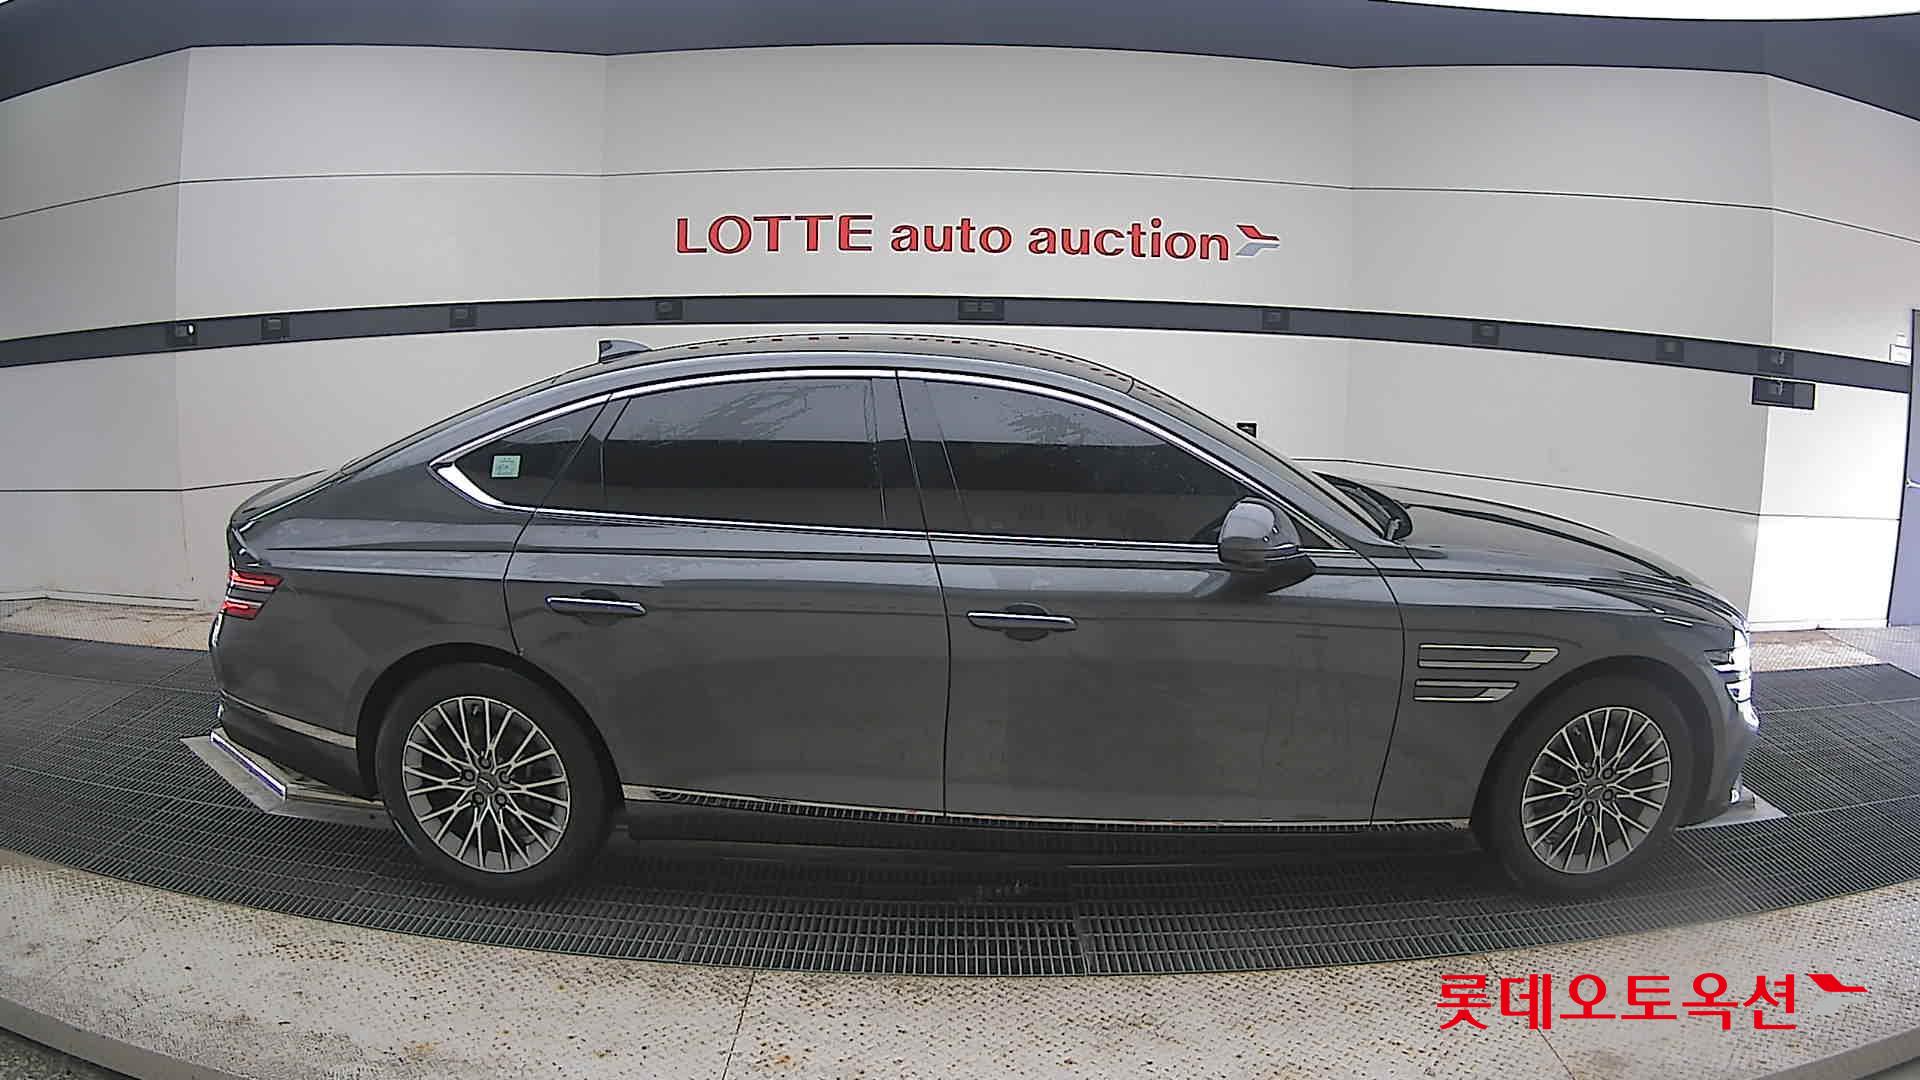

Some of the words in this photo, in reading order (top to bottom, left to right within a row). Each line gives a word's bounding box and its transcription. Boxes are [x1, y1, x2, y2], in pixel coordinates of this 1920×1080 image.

[676, 215, 873, 254] LOTTE
[890, 217, 1012, 253] auto
[1029, 218, 1229, 261] auction
